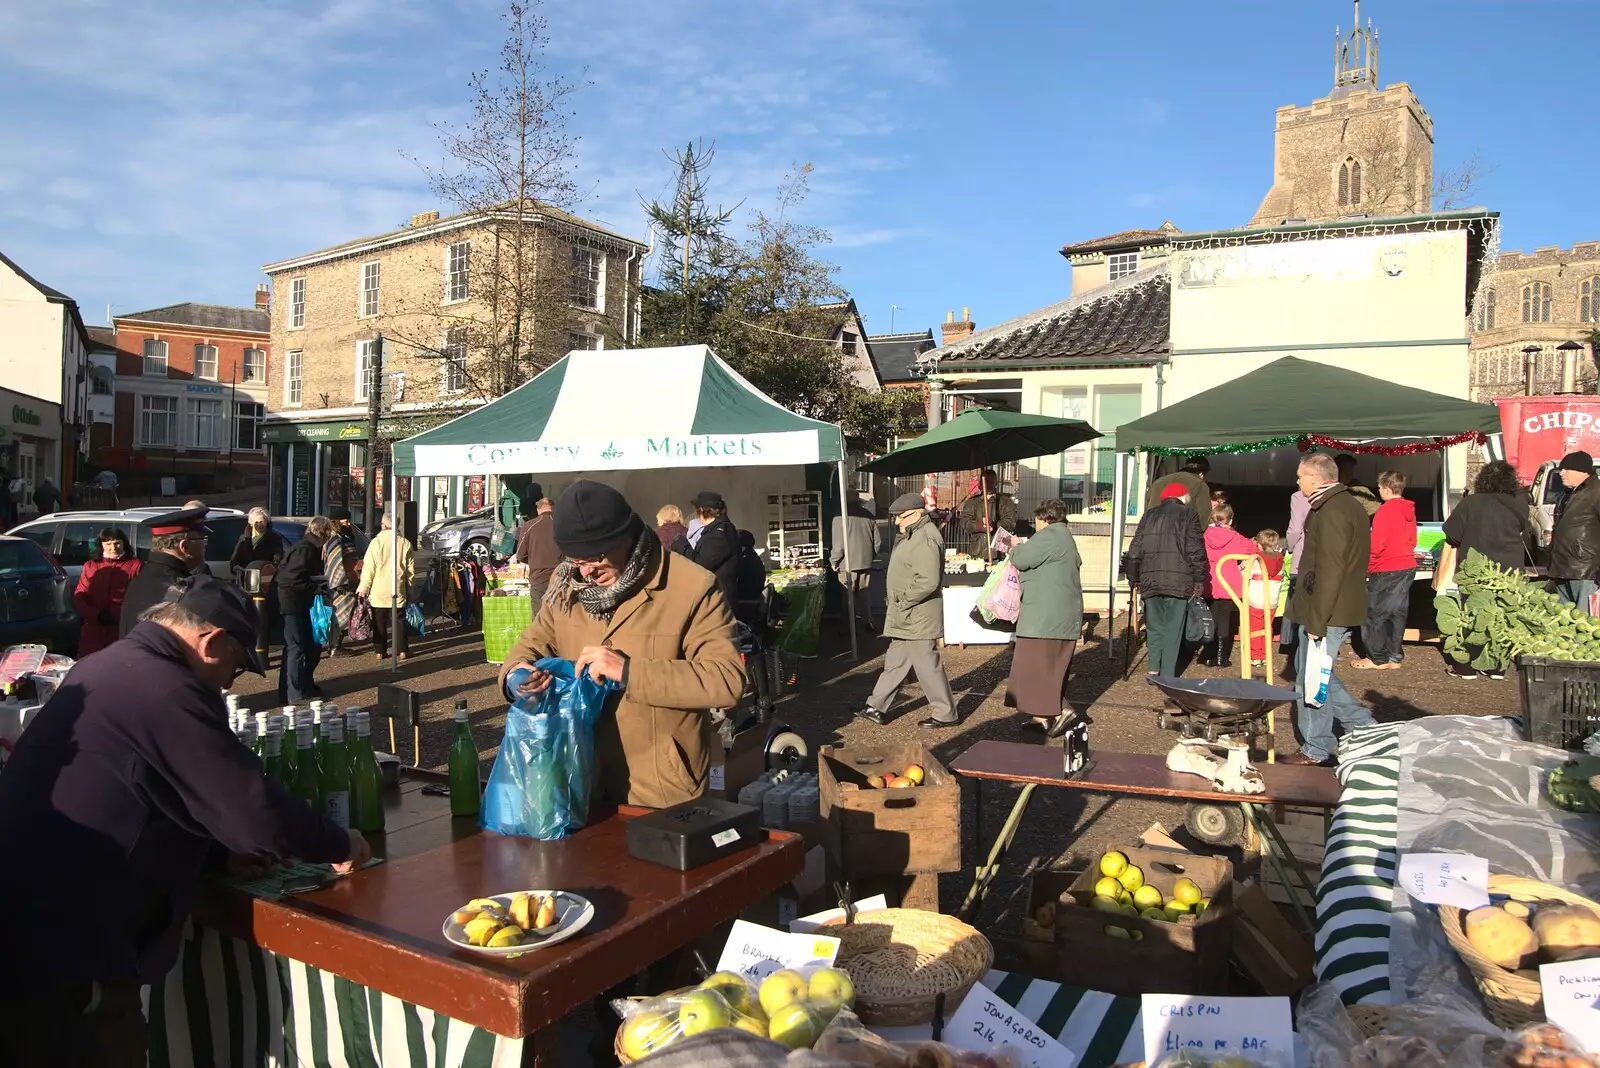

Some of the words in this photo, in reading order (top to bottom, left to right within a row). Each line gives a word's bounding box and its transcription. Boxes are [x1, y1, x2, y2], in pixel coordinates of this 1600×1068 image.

[306, 428, 330, 436] CLEANING
[468, 444, 581, 467] Cotry
[647, 435, 762, 457] Markets
[1160, 1004, 1220, 1017] CRISPIN
